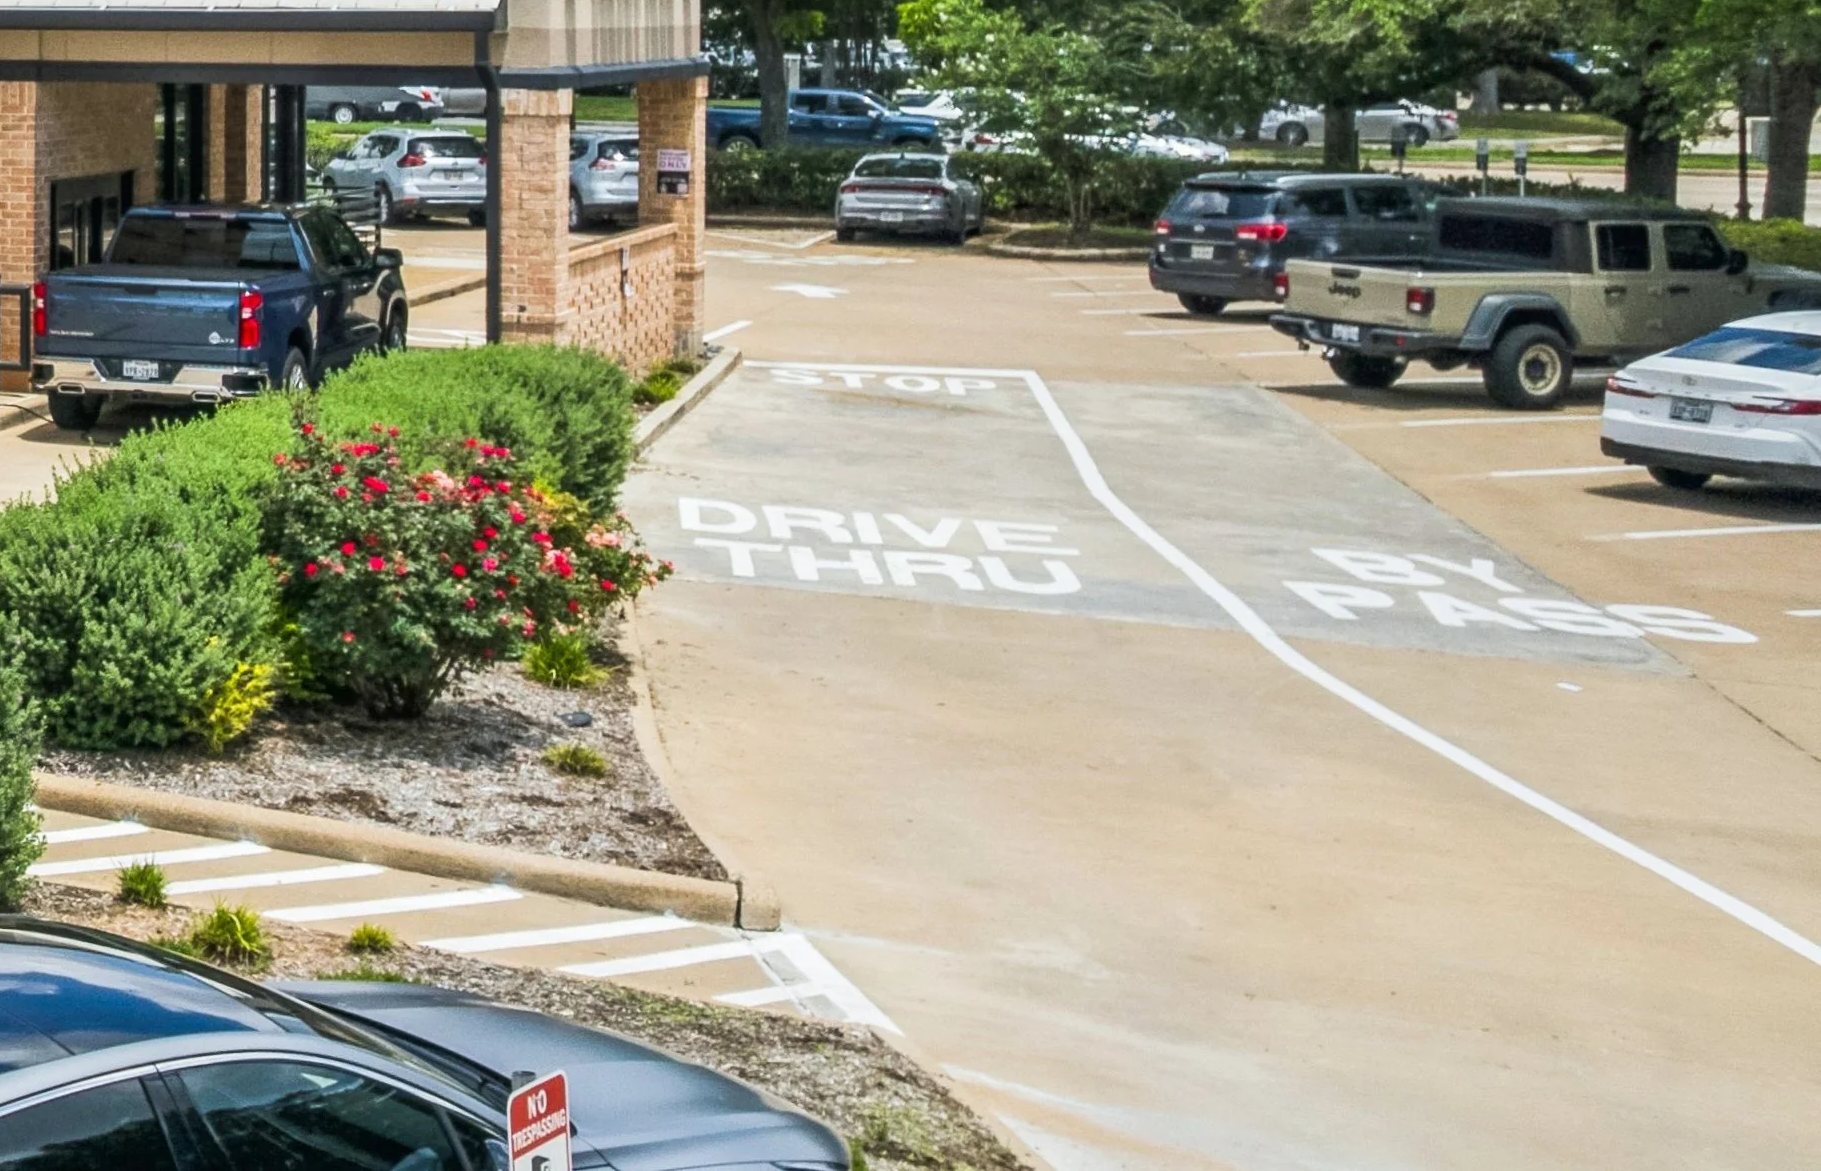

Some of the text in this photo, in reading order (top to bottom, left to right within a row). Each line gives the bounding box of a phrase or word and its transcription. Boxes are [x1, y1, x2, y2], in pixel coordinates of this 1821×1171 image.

[1328, 281, 1361, 298] Jeep
[769, 369, 997, 396] STOP
[678, 497, 1081, 556] DRIVE
[693, 537, 1083, 595] THRU
[1311, 547, 1525, 593] BY
[1281, 580, 1758, 644] PASS
[526, 1088, 548, 1120] NO
[512, 1108, 566, 1151] TRESPASSING
